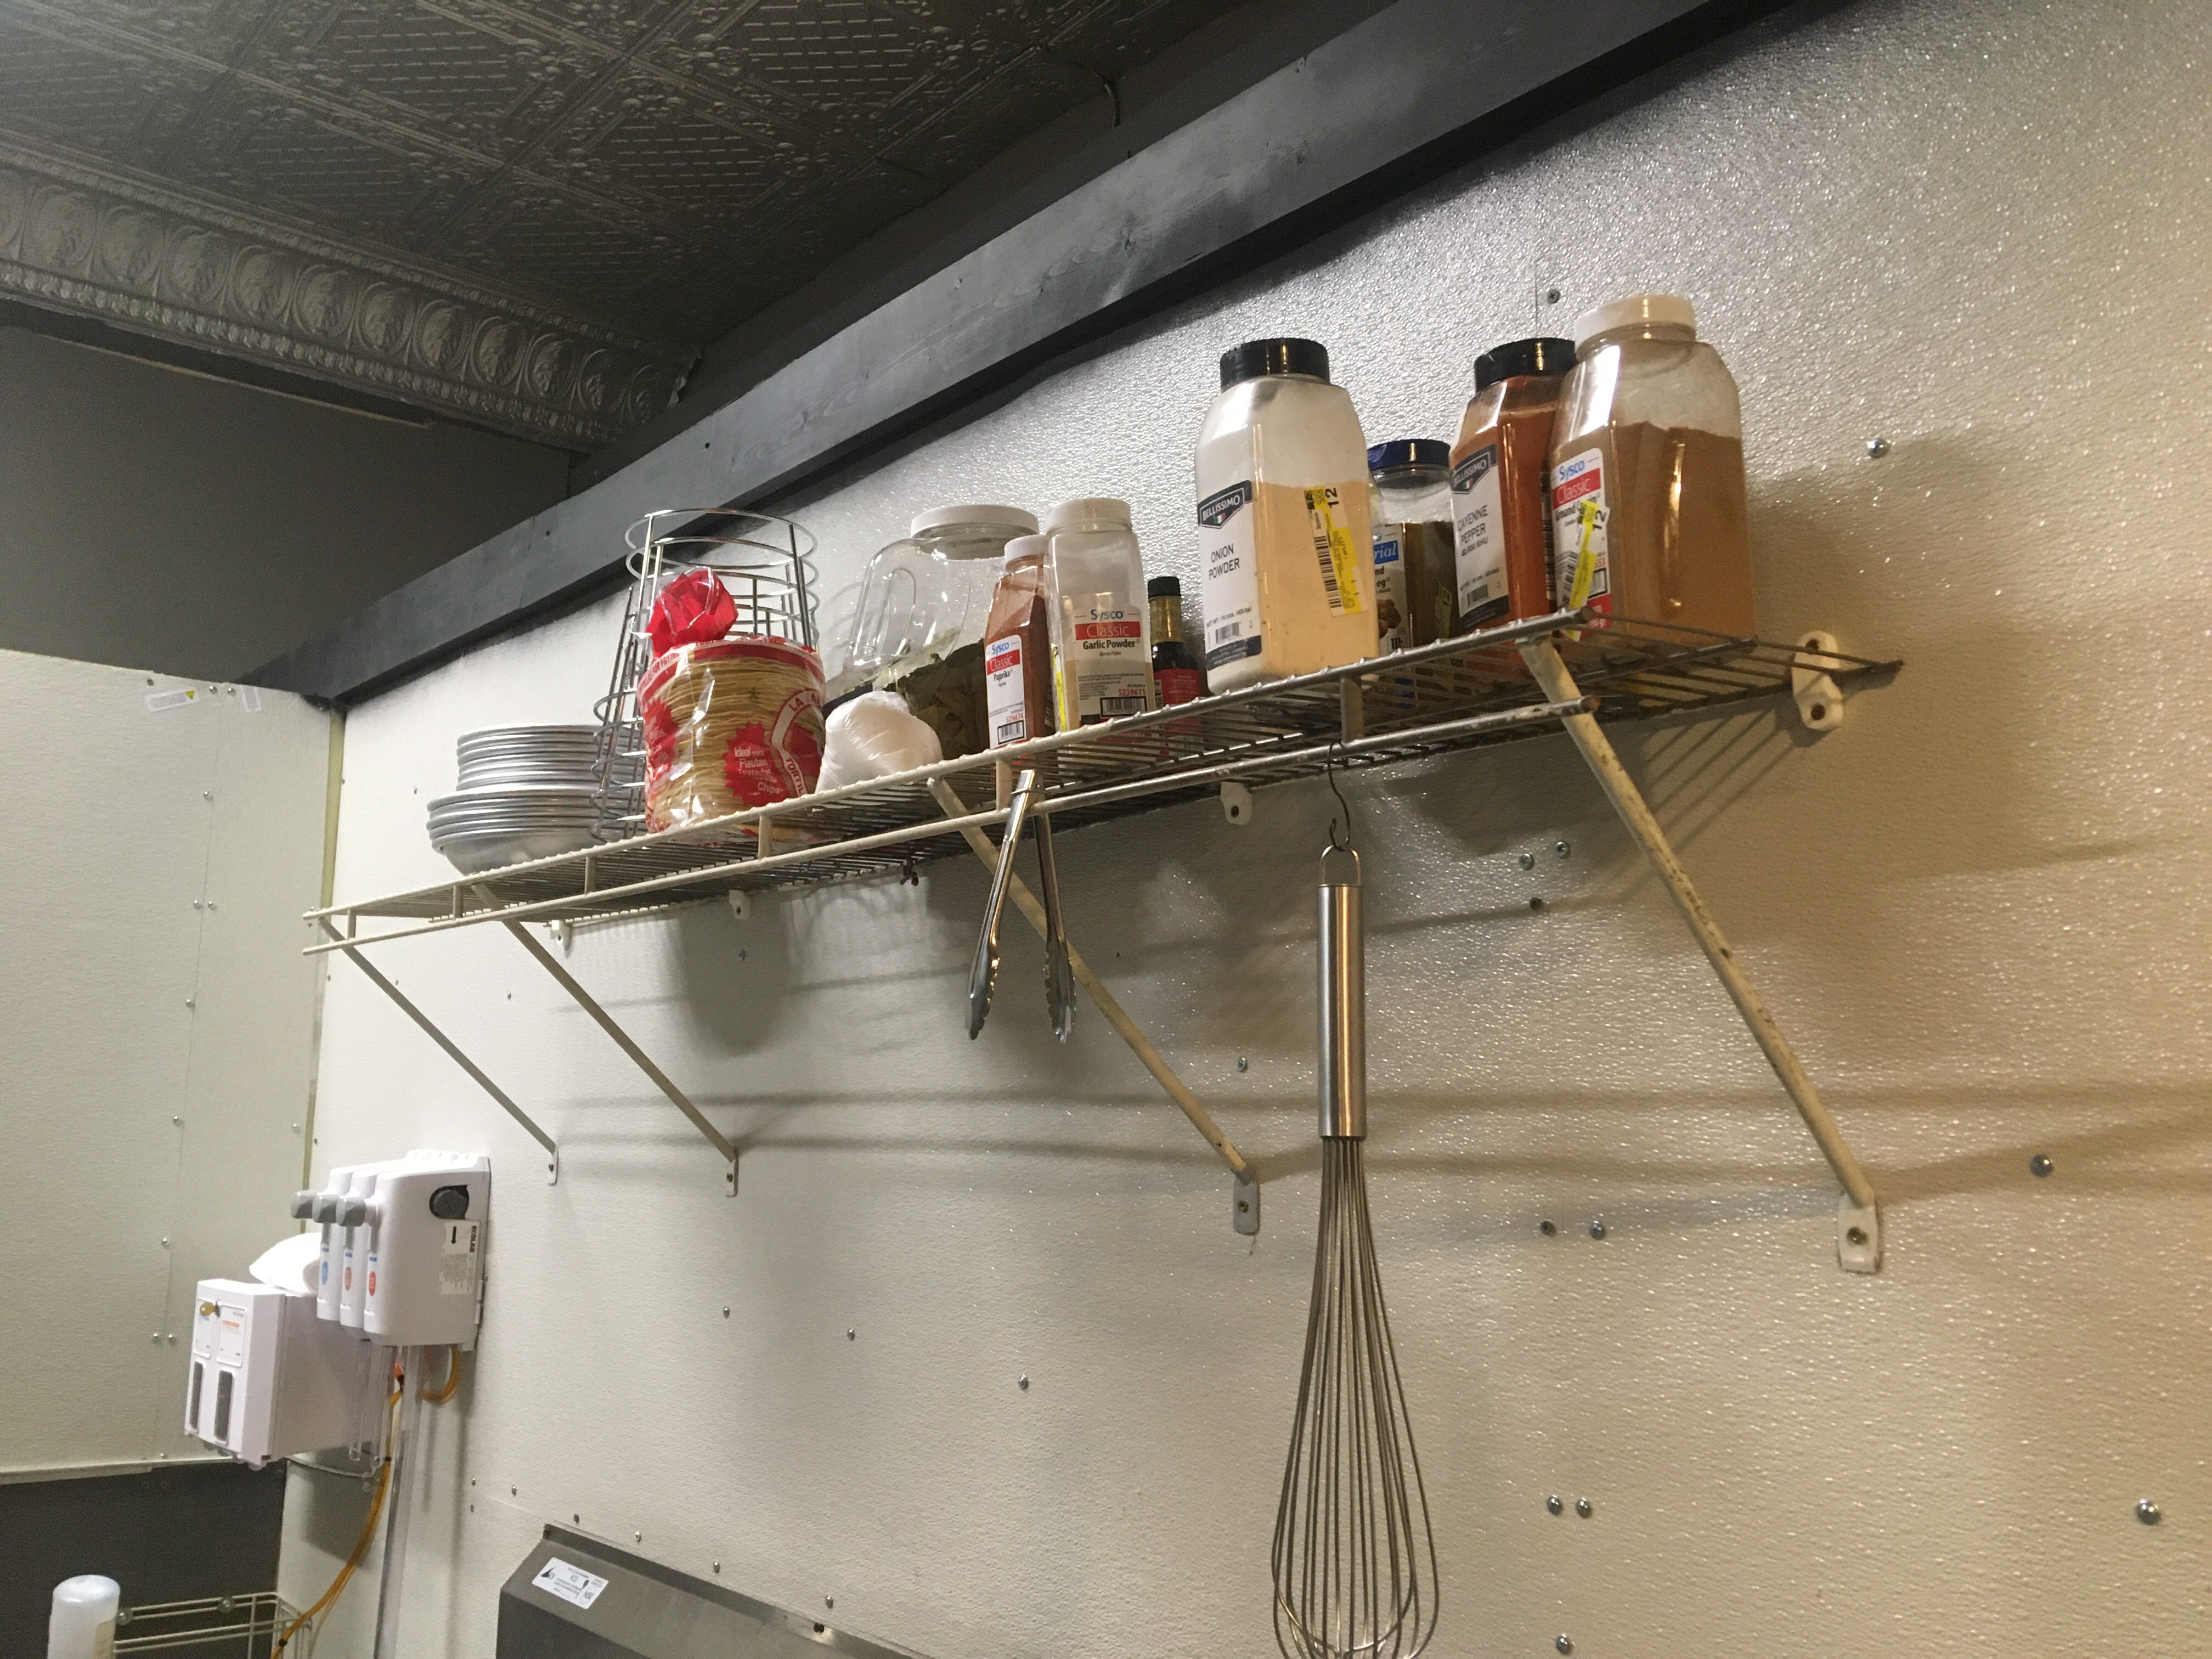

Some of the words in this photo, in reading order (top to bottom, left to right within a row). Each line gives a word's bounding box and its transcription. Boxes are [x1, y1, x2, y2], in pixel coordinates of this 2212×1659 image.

[1454, 459, 1487, 487] BELLISSIMO
[1559, 461, 1585, 481] Sysco
[1325, 487, 1339, 509] 12
[1556, 478, 1590, 504] Classic
[1202, 494, 1240, 521] BELLISSIMO
[1457, 505, 1488, 532] CAYENNE
[1593, 510, 1607, 531] 12
[1460, 523, 1486, 546] PEPPER
[1211, 543, 1234, 563] ONION
[1209, 558, 1240, 580] POWDER
[1091, 609, 1124, 622] Sysco
[1087, 624, 1130, 638] Classic
[992, 642, 1009, 654] Sysco
[1083, 640, 1105, 650] Garlic
[1106, 639, 1136, 648] Powder
[990, 656, 1013, 672] Classic
[994, 670, 1011, 681] Paprika
[788, 697, 804, 712] LA
[735, 746, 751, 758] Ideal
